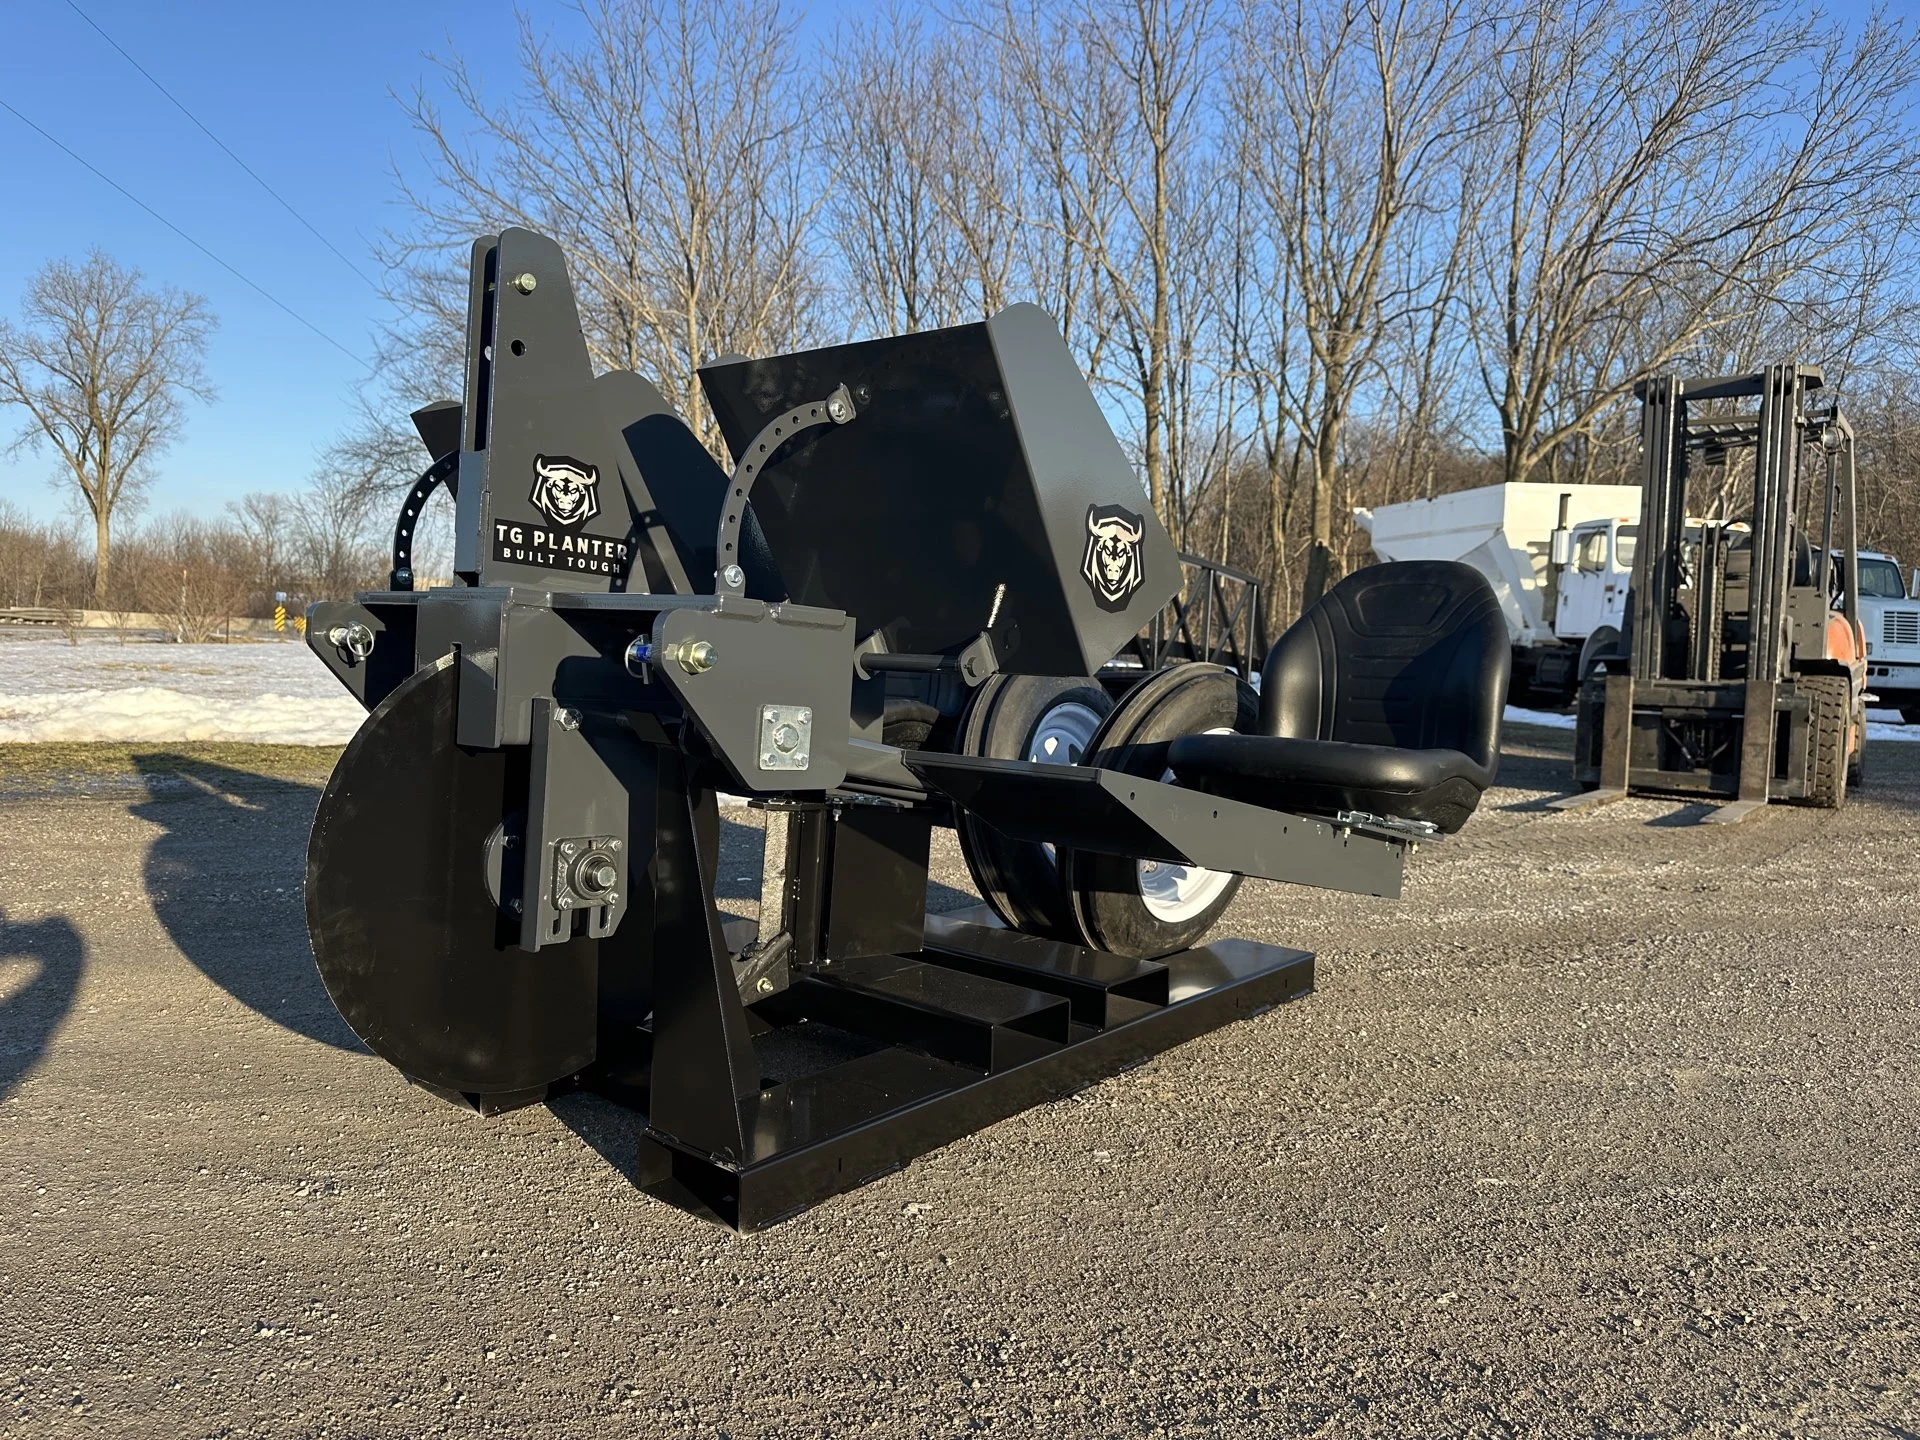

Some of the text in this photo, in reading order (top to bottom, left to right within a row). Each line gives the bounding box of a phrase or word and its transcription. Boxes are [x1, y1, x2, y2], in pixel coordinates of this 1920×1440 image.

[496, 524, 627, 559] TG PLANTER
[503, 548, 620, 573] BUILT TOUGH
